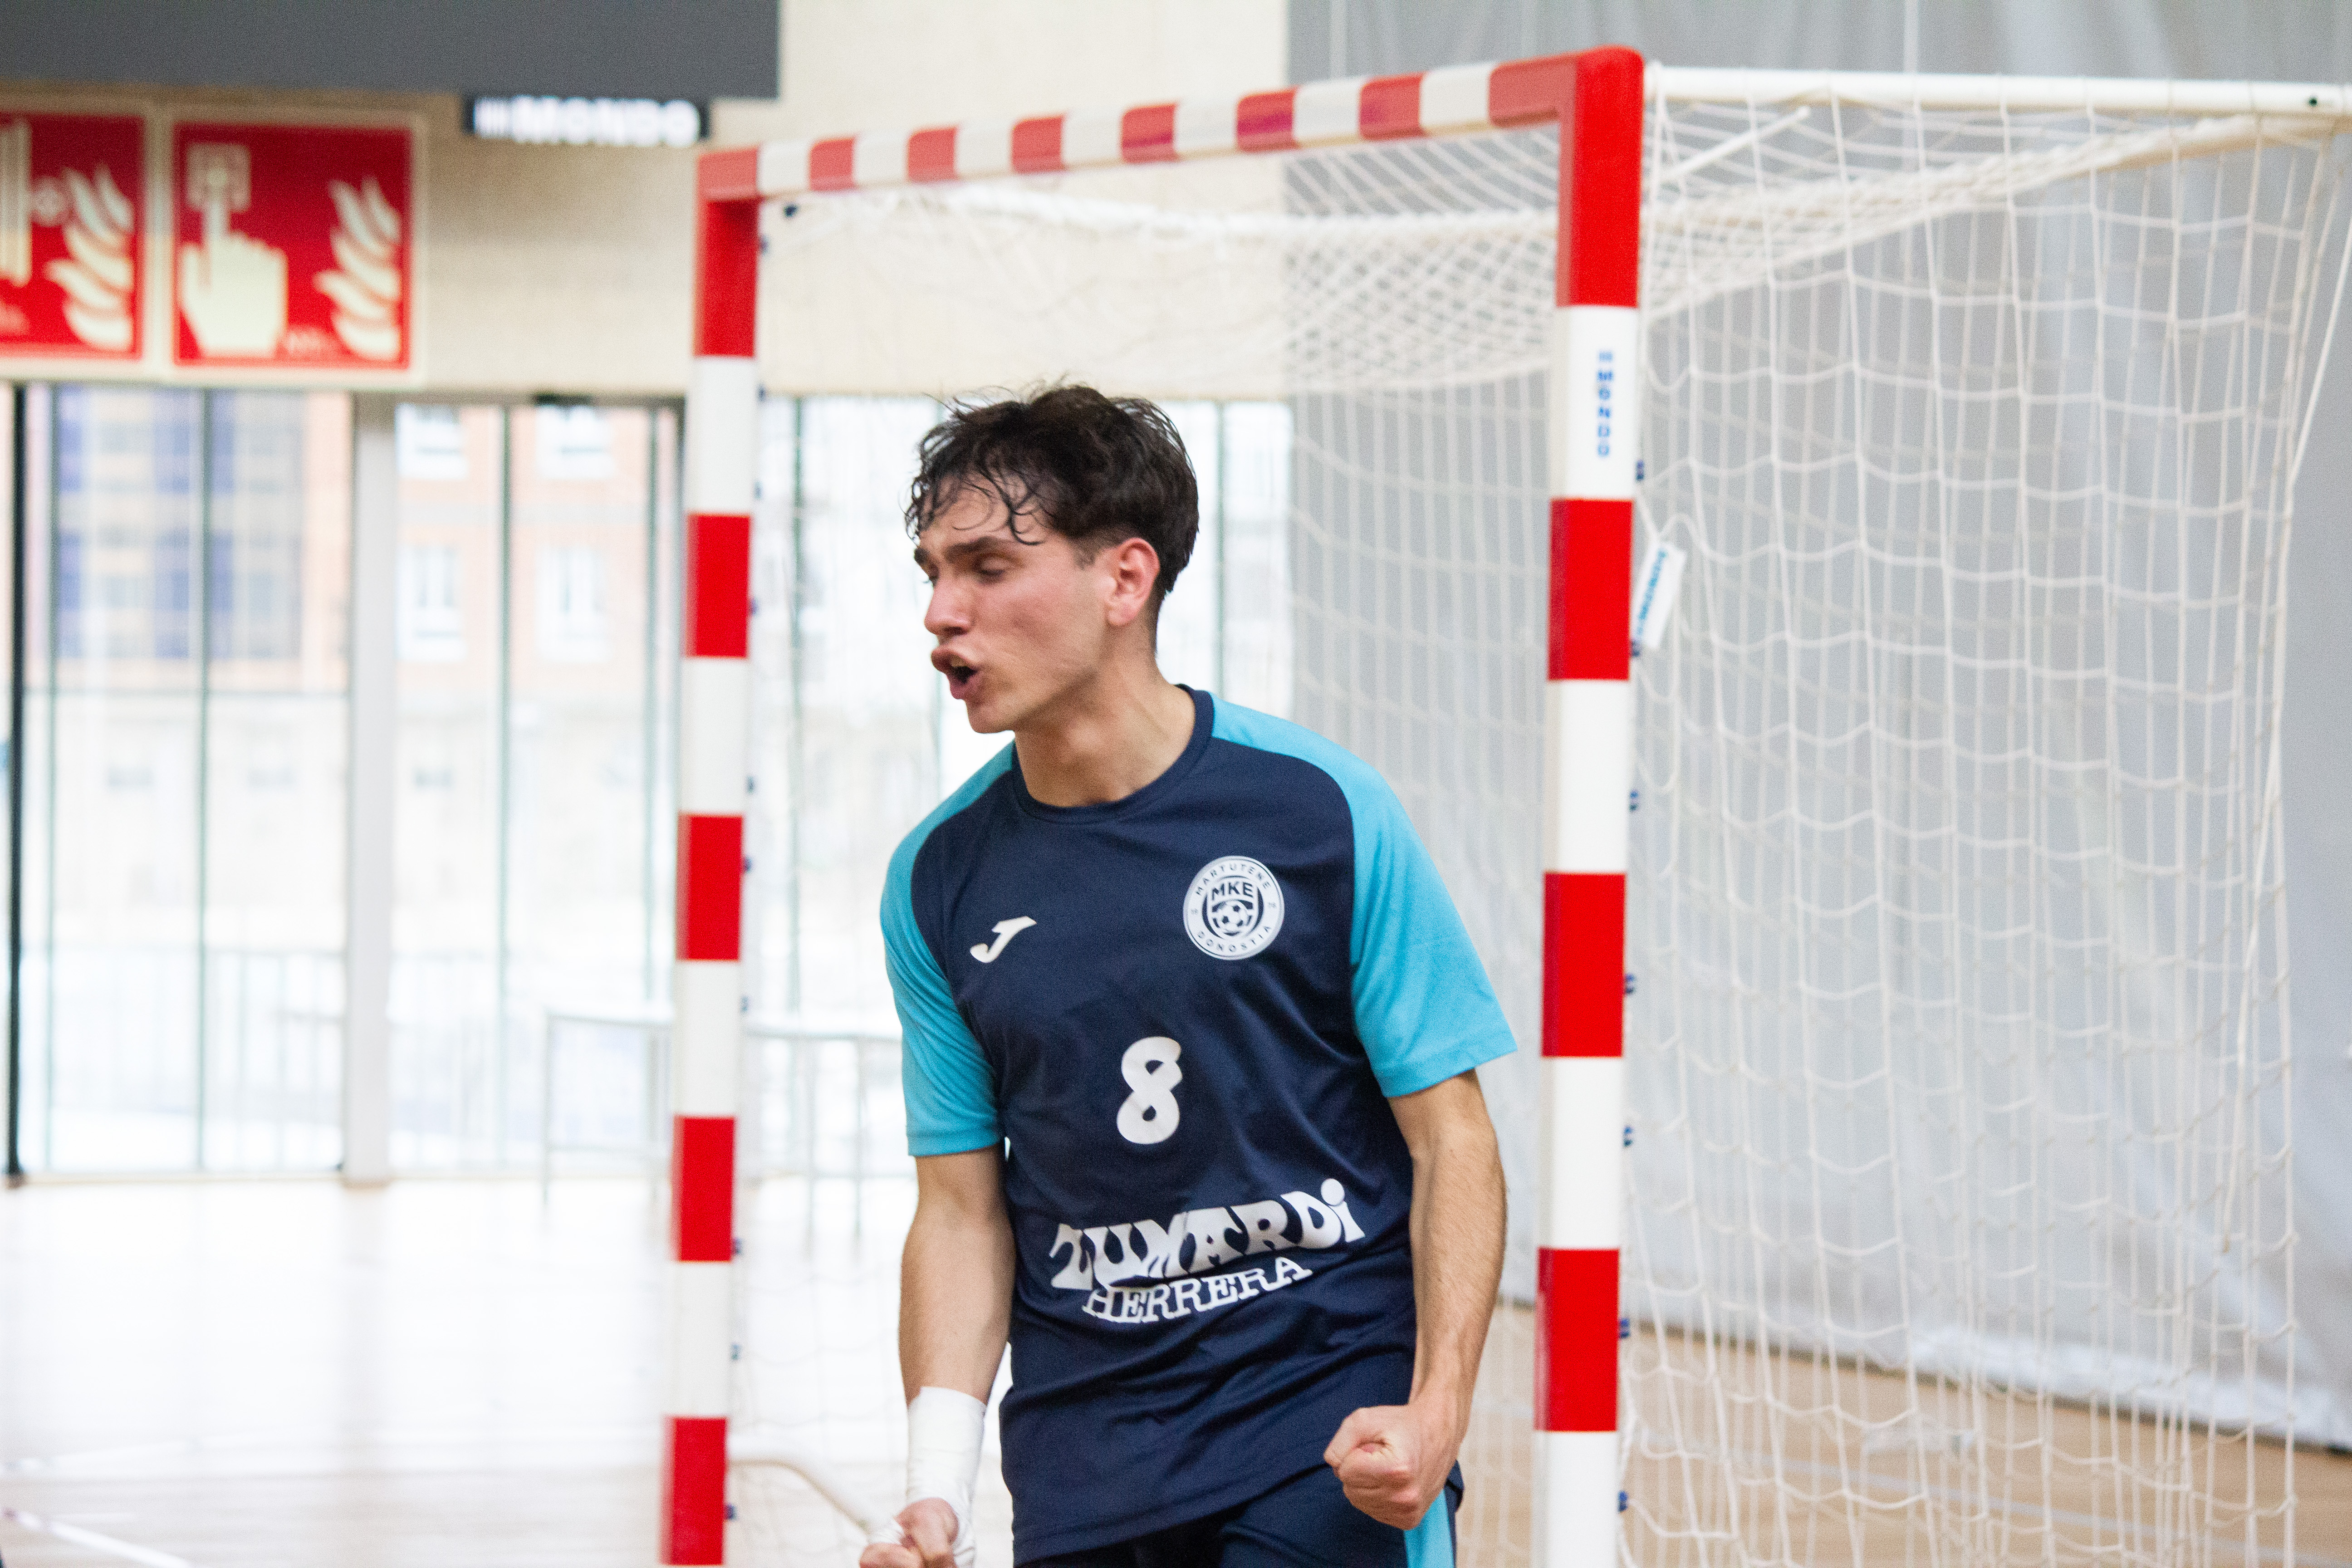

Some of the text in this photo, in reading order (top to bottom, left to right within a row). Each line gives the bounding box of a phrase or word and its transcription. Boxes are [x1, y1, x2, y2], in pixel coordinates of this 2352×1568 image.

[1596, 369, 1613, 457] MONDO
[1195, 863, 1270, 895] MARTUTENE
[1211, 881, 1254, 901] MKE
[1197, 926, 1271, 952] DONOSTIA
[1116, 1036, 1182, 1144] 8
[1082, 1256, 1313, 1323] HERRERA
